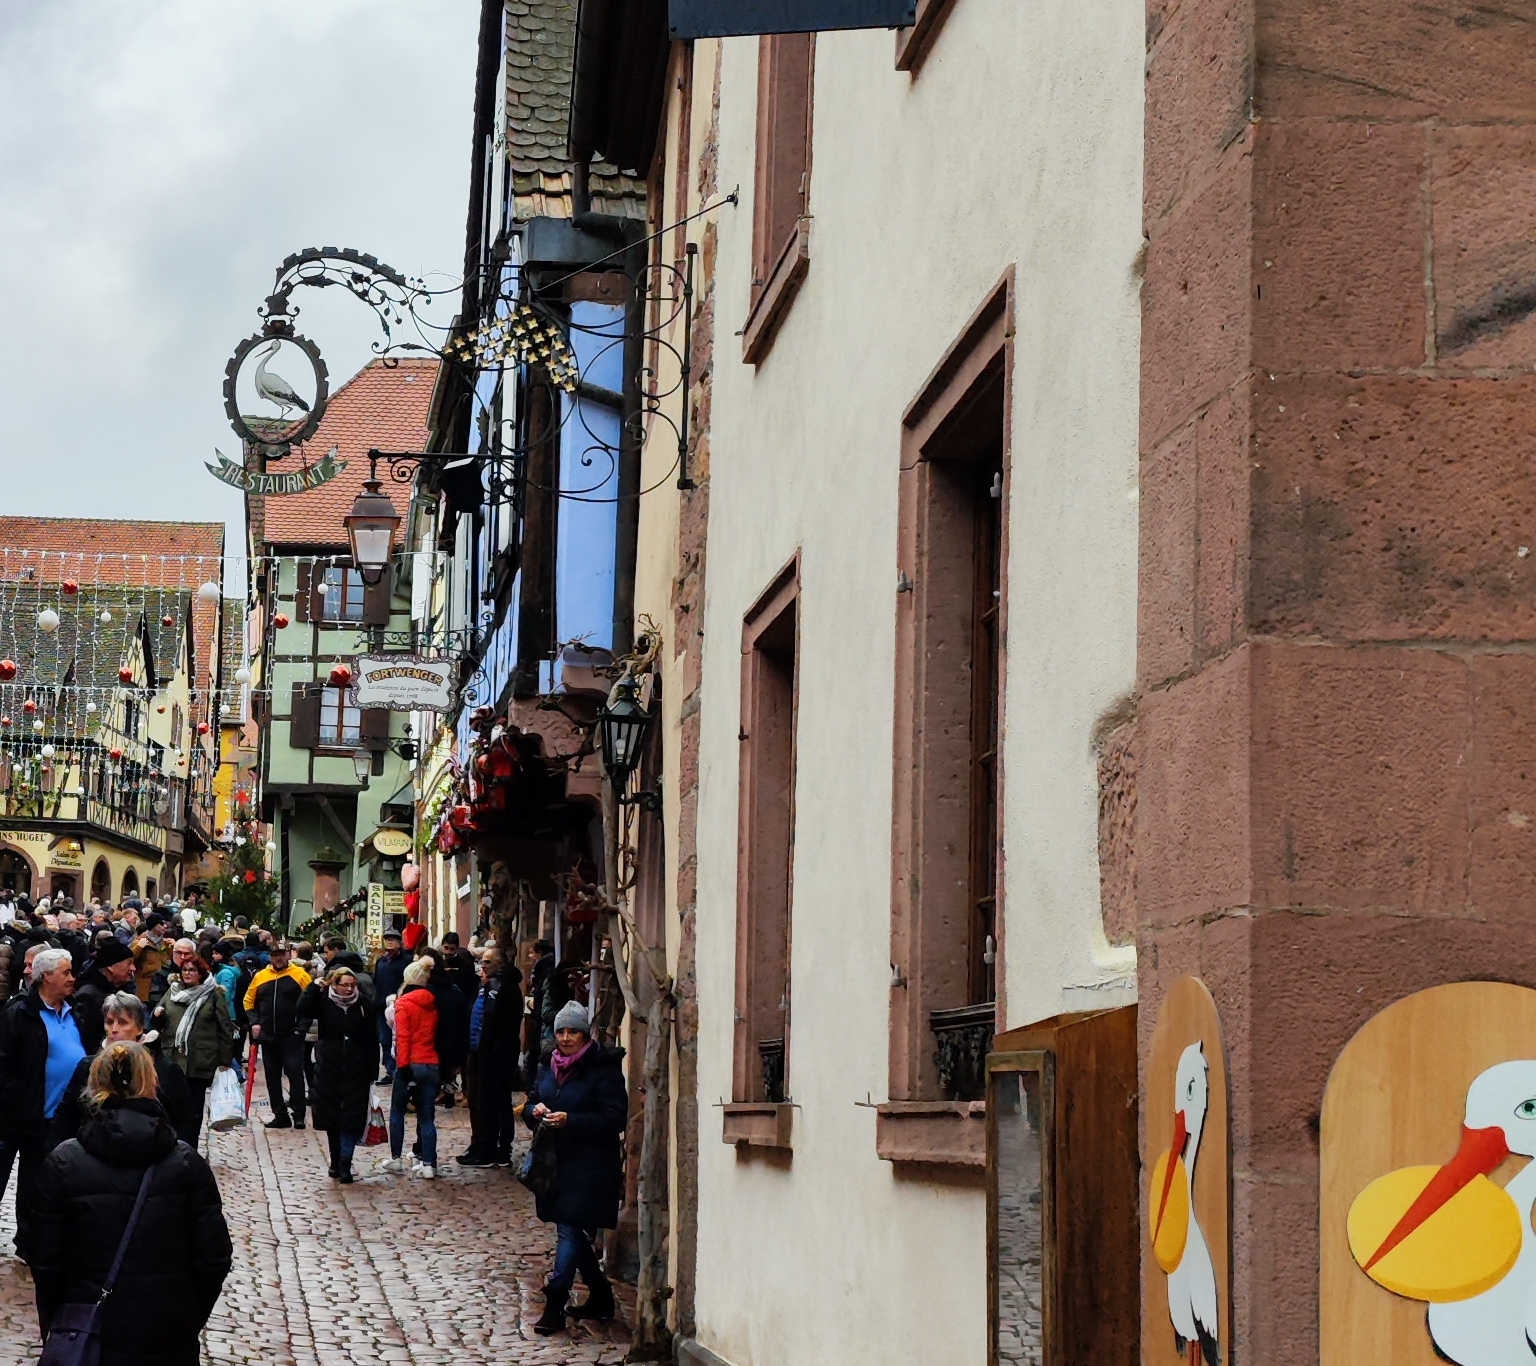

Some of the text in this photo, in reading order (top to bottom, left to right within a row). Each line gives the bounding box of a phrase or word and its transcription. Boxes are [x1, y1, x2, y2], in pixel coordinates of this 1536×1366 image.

[223, 464, 325, 494] RESTAURANT
[365, 667, 444, 687] FORTWENGER
[369, 885, 381, 917] SALON
